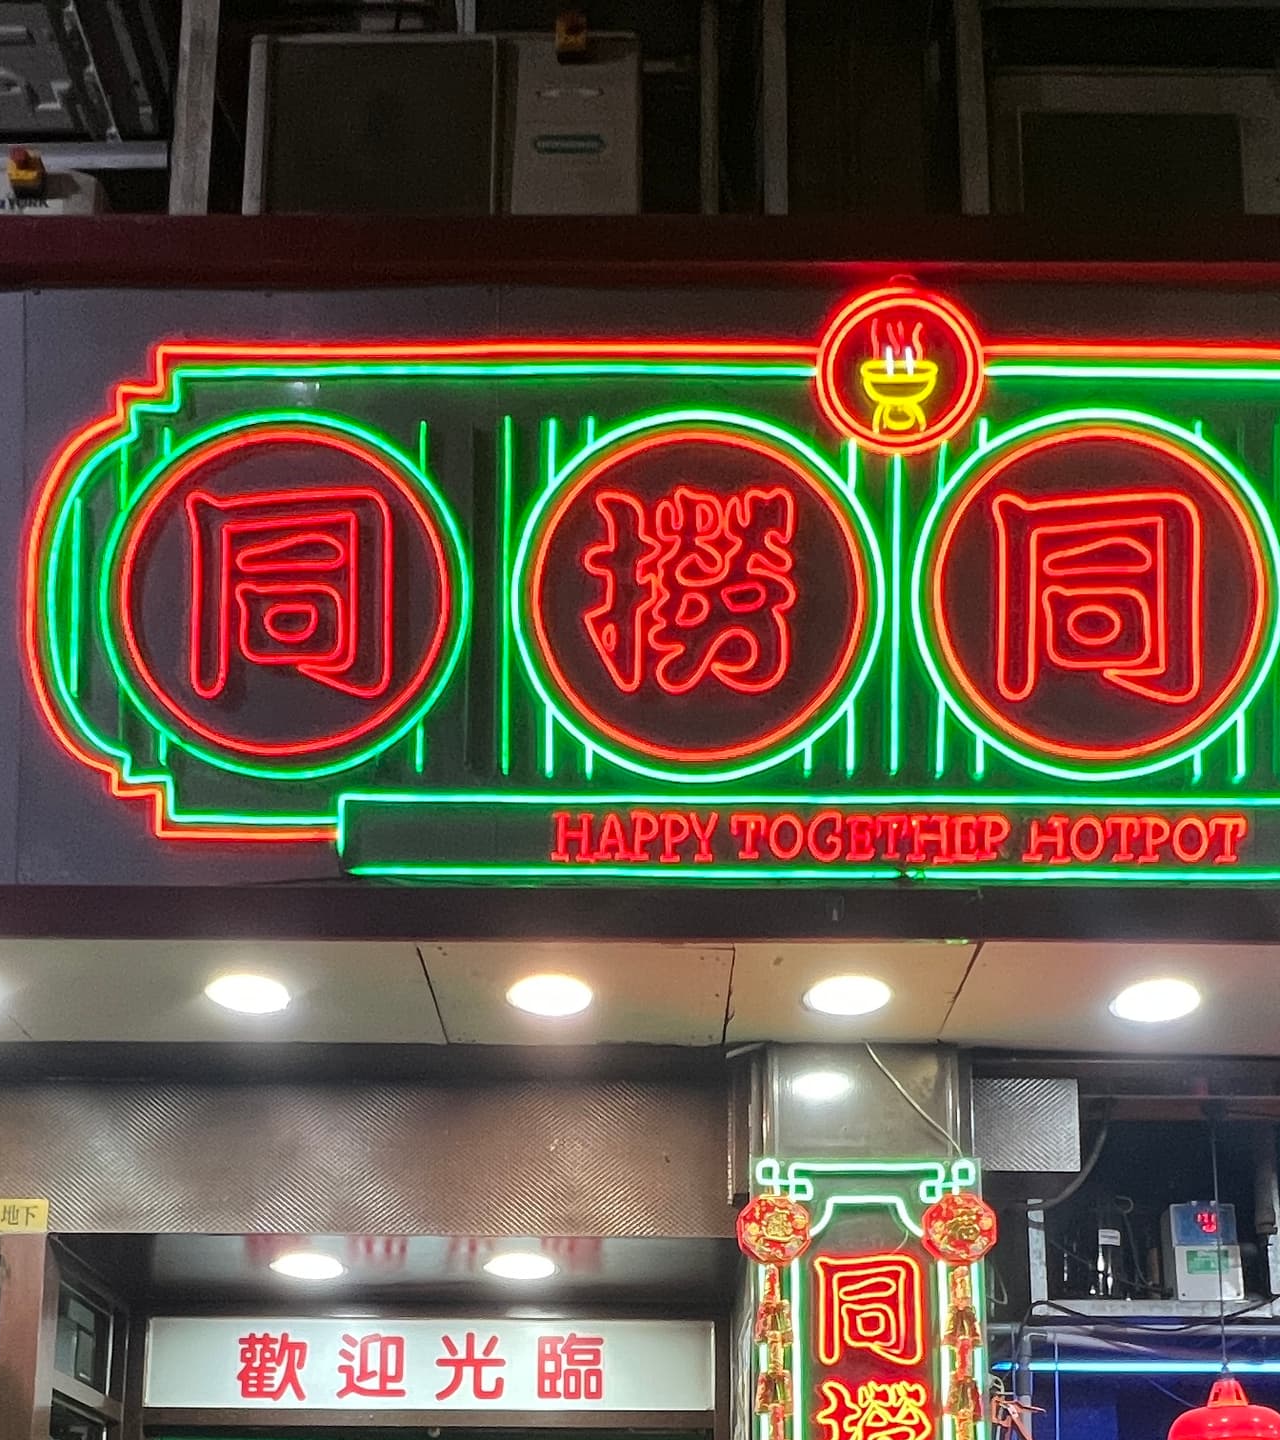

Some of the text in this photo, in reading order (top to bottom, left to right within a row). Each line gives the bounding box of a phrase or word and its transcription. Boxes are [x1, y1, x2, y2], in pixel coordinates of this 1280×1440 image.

[550, 811, 1248, 865] HAPPY TOGETHER HOTPOT
[236, 1332, 604, 1402] 歡迎光臨
